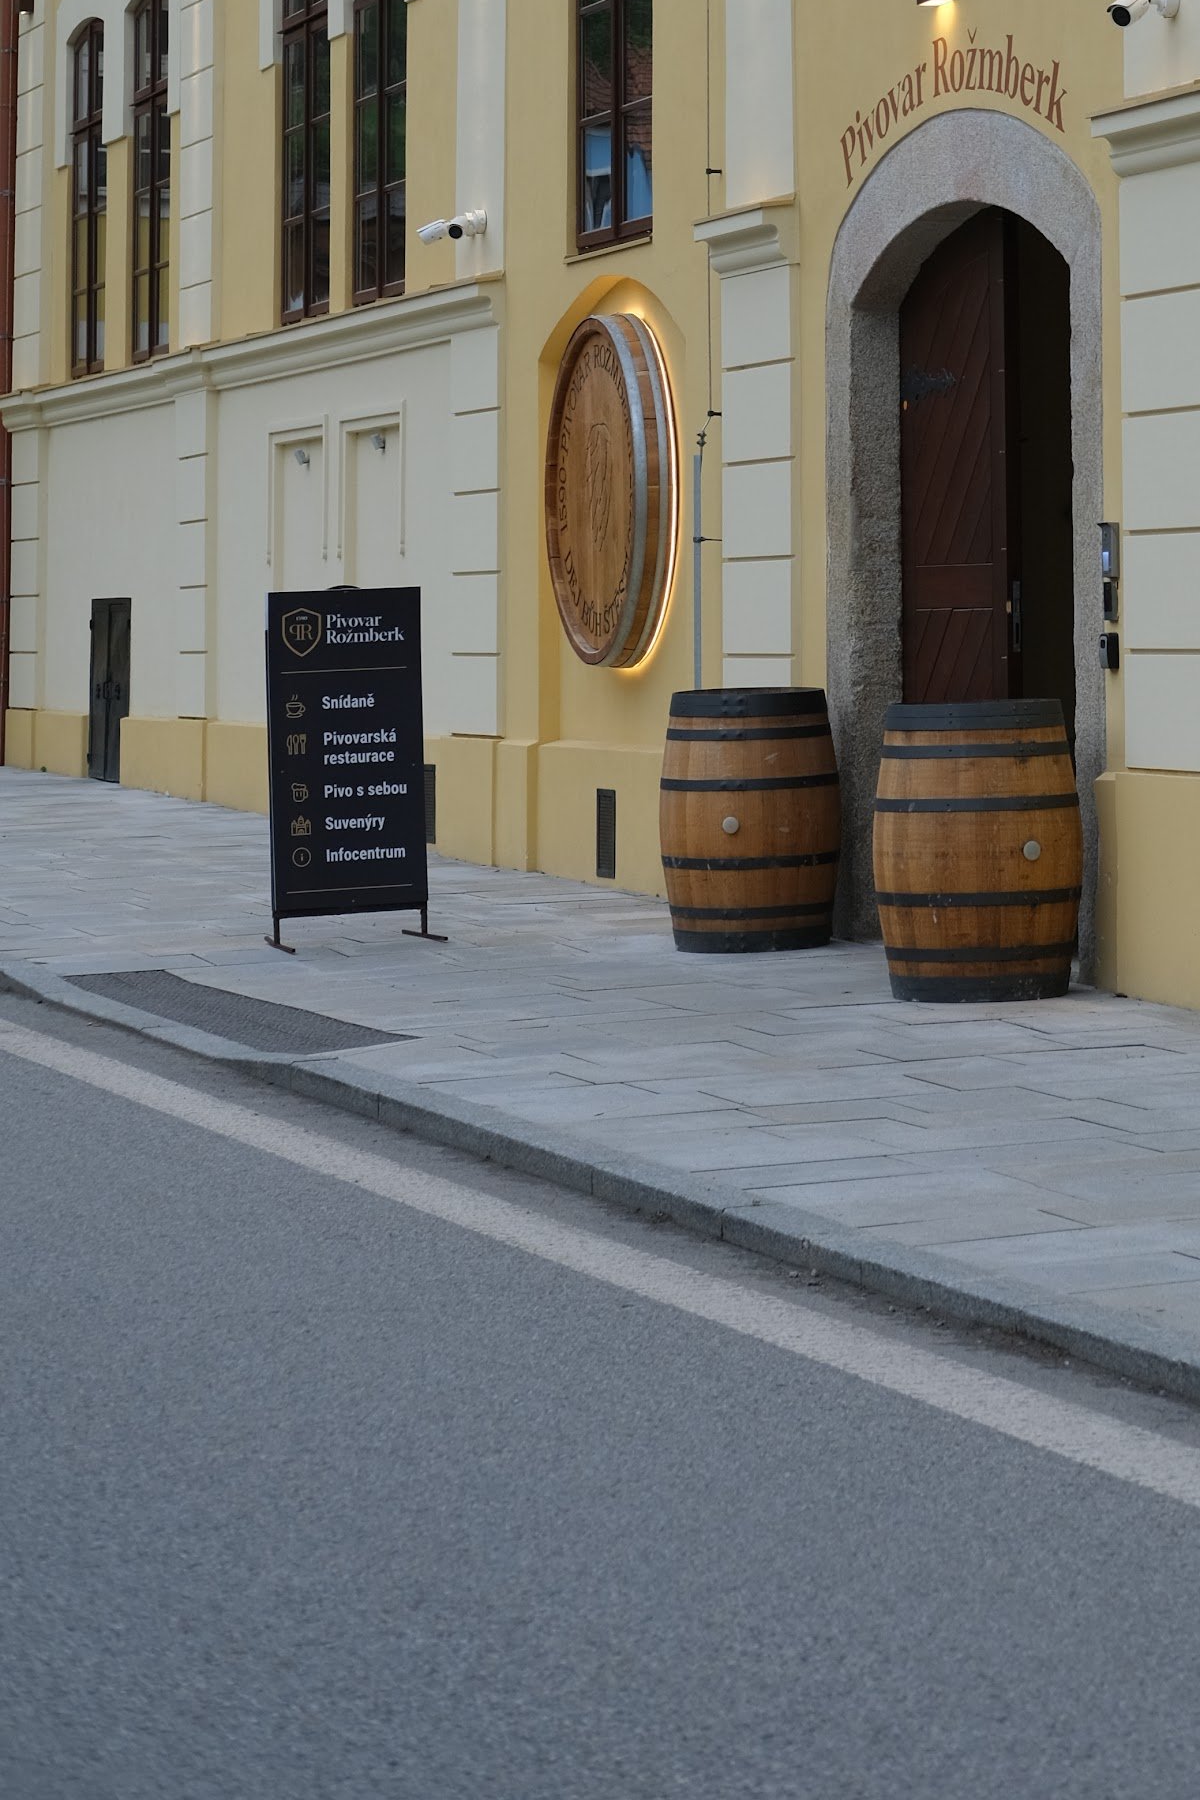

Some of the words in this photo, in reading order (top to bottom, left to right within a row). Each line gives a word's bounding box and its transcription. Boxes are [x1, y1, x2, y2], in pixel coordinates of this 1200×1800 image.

[839, 62, 927, 189] Pivovar
[932, 27, 1068, 133] Rožmberk
[326, 613, 382, 629] Pivovar
[326, 622, 405, 644] Rožmberk
[321, 693, 375, 710] Snídaně
[323, 728, 397, 746] Pivovarská
[323, 751, 395, 766] restaurace
[324, 784, 354, 799] Pivo
[356, 785, 365, 797] s
[367, 781, 408, 796] sebou
[324, 813, 386, 831] Suvenýry
[326, 847, 406, 863] Infocentrum
